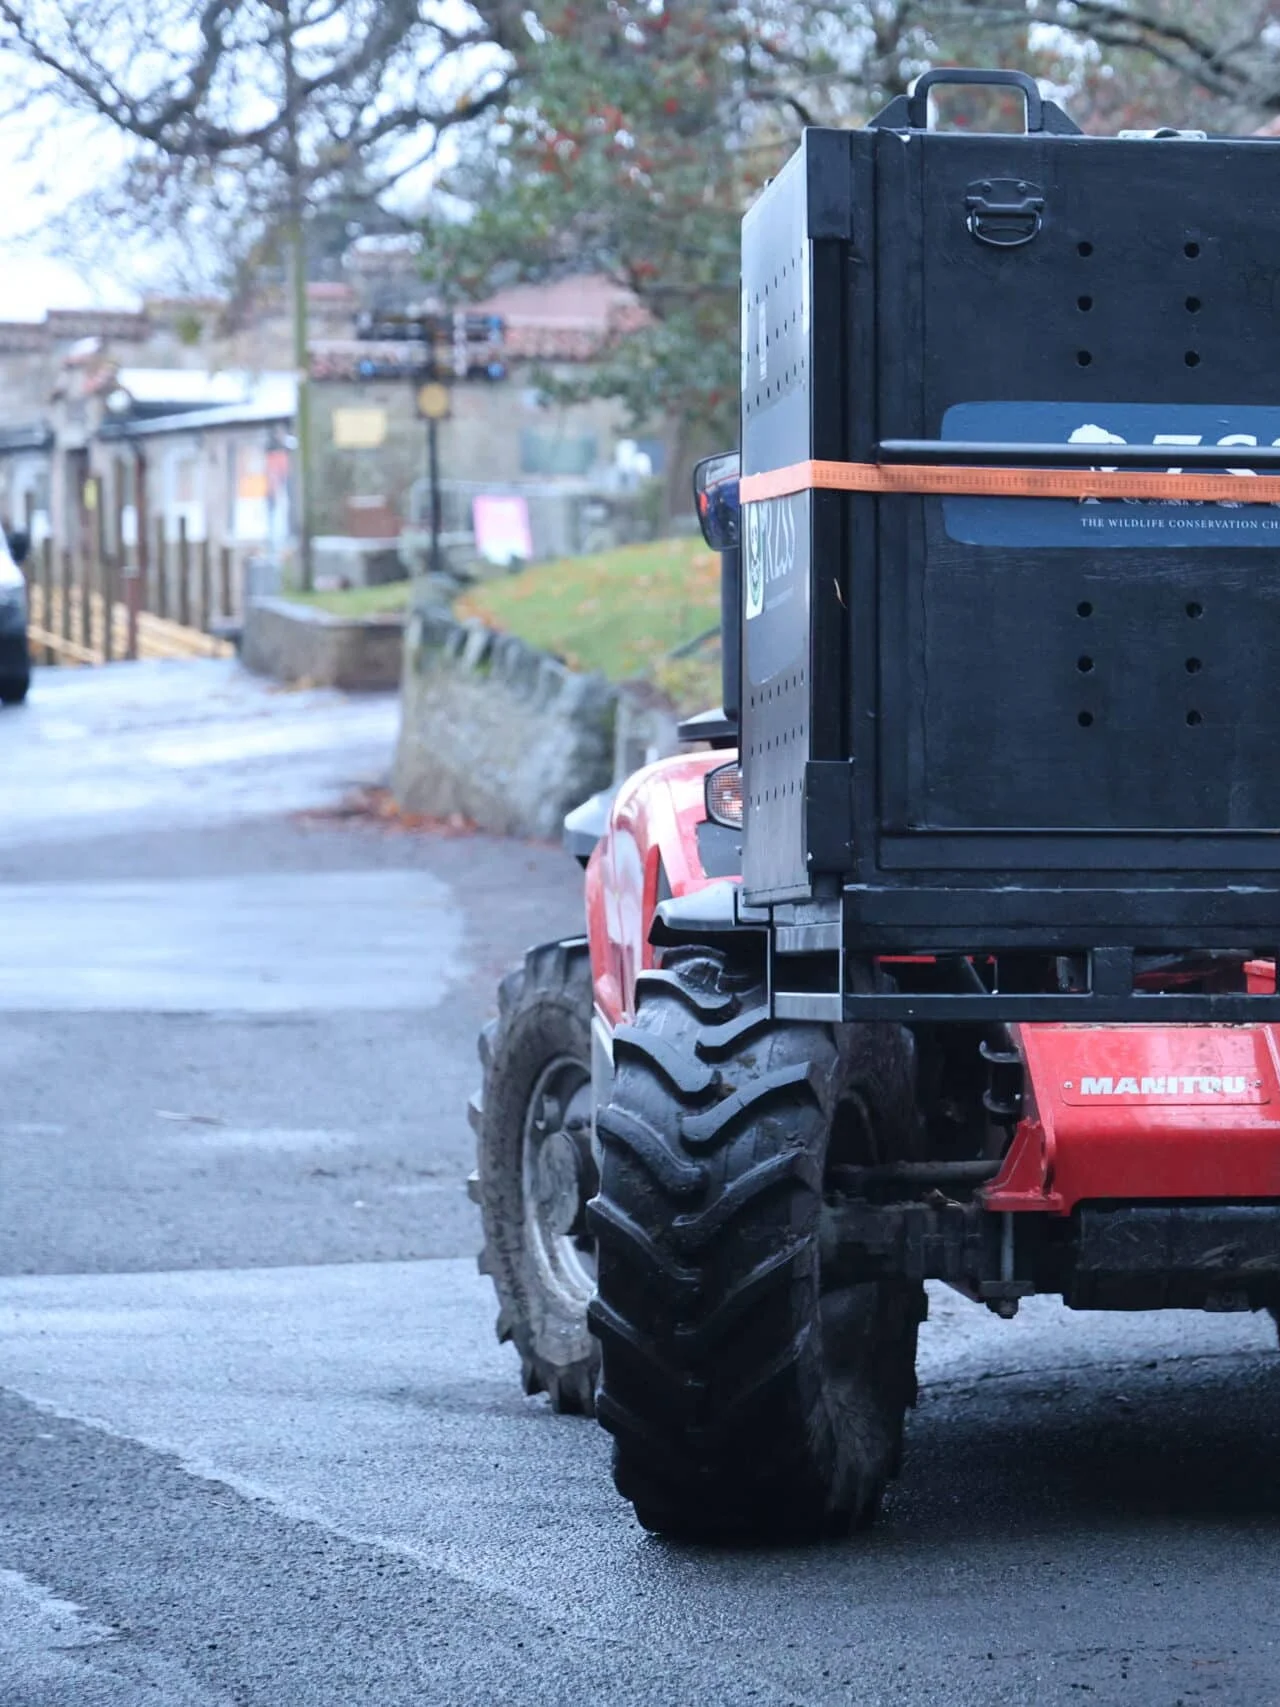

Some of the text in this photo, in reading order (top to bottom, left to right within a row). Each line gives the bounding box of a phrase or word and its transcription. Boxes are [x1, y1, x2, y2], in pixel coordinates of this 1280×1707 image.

[1080, 517, 1104, 528] THE
[1108, 518, 1165, 528] WILDLIFE
[1168, 518, 1258, 529] CONSERVATION
[1080, 1076, 1247, 1095] MANITOU
